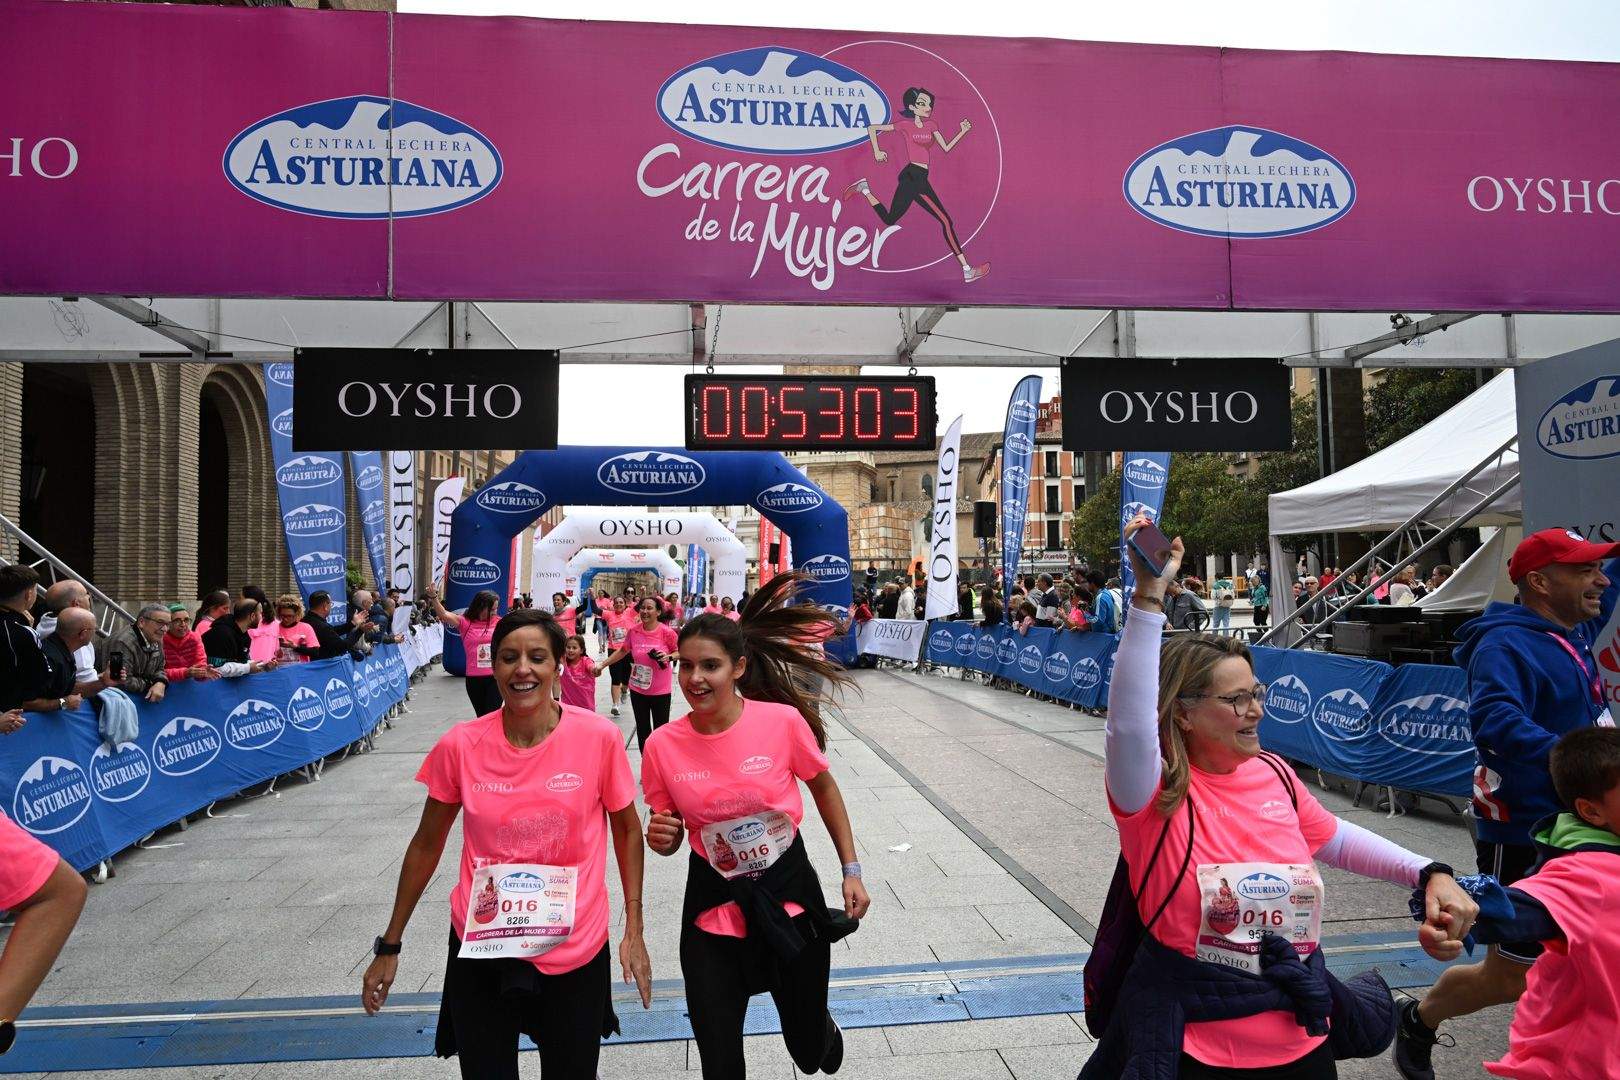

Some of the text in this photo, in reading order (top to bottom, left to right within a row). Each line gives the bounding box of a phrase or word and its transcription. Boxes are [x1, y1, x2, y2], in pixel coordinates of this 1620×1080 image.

[712, 82, 866, 98] CENTRAL LECHERA
[675, 82, 872, 129] ASTURIANA
[289, 137, 472, 152] CENTRAL LECHERA
[245, 139, 482, 188] ASTURIANA
[1178, 163, 1331, 177] CENTRAL LECHERA
[637, 143, 830, 204] Carrera
[1143, 165, 1340, 210] ASTURIANA
[685, 199, 902, 291] de la Mujer
[338, 381, 522, 418] OYSHO
[1099, 390, 1259, 424] OYSHO
[1565, 403, 1609, 420] CENTRAL
[606, 464, 698, 484] ASTURIANA
[480, 493, 541, 506] ASTURIANA
[762, 495, 819, 506] ASTURIANA
[932, 447, 956, 583] OYSHO
[599, 519, 683, 536] OYSHO
[451, 568, 497, 579] ASTURIANA
[874, 622, 913, 642] OYSHO
[1265, 689, 1306, 715] ASTURIANA
[230, 716, 282, 743] ASTURIANA
[1384, 712, 1474, 743] ASTURIAN
[158, 736, 218, 768] ASTURIANA
[95, 760, 149, 792] ASTURIANA
[672, 770, 711, 783] OYSHO
[472, 782, 513, 793] OYSHO
[21, 780, 90, 825] ASTURIANA
[739, 844, 769, 861] 016
[748, 859, 768, 870] 8287
[502, 879, 542, 889] ASTURIANA
[1241, 884, 1286, 894] ASTURIANA
[1292, 878, 1315, 886] SUMA
[502, 899, 538, 913] 016
[506, 916, 530, 926] 8286
[1242, 909, 1284, 926] 016
[476, 931, 504, 939] CARRERA
[470, 944, 504, 953] OYSHO
[1207, 951, 1250, 970] OYSHO
